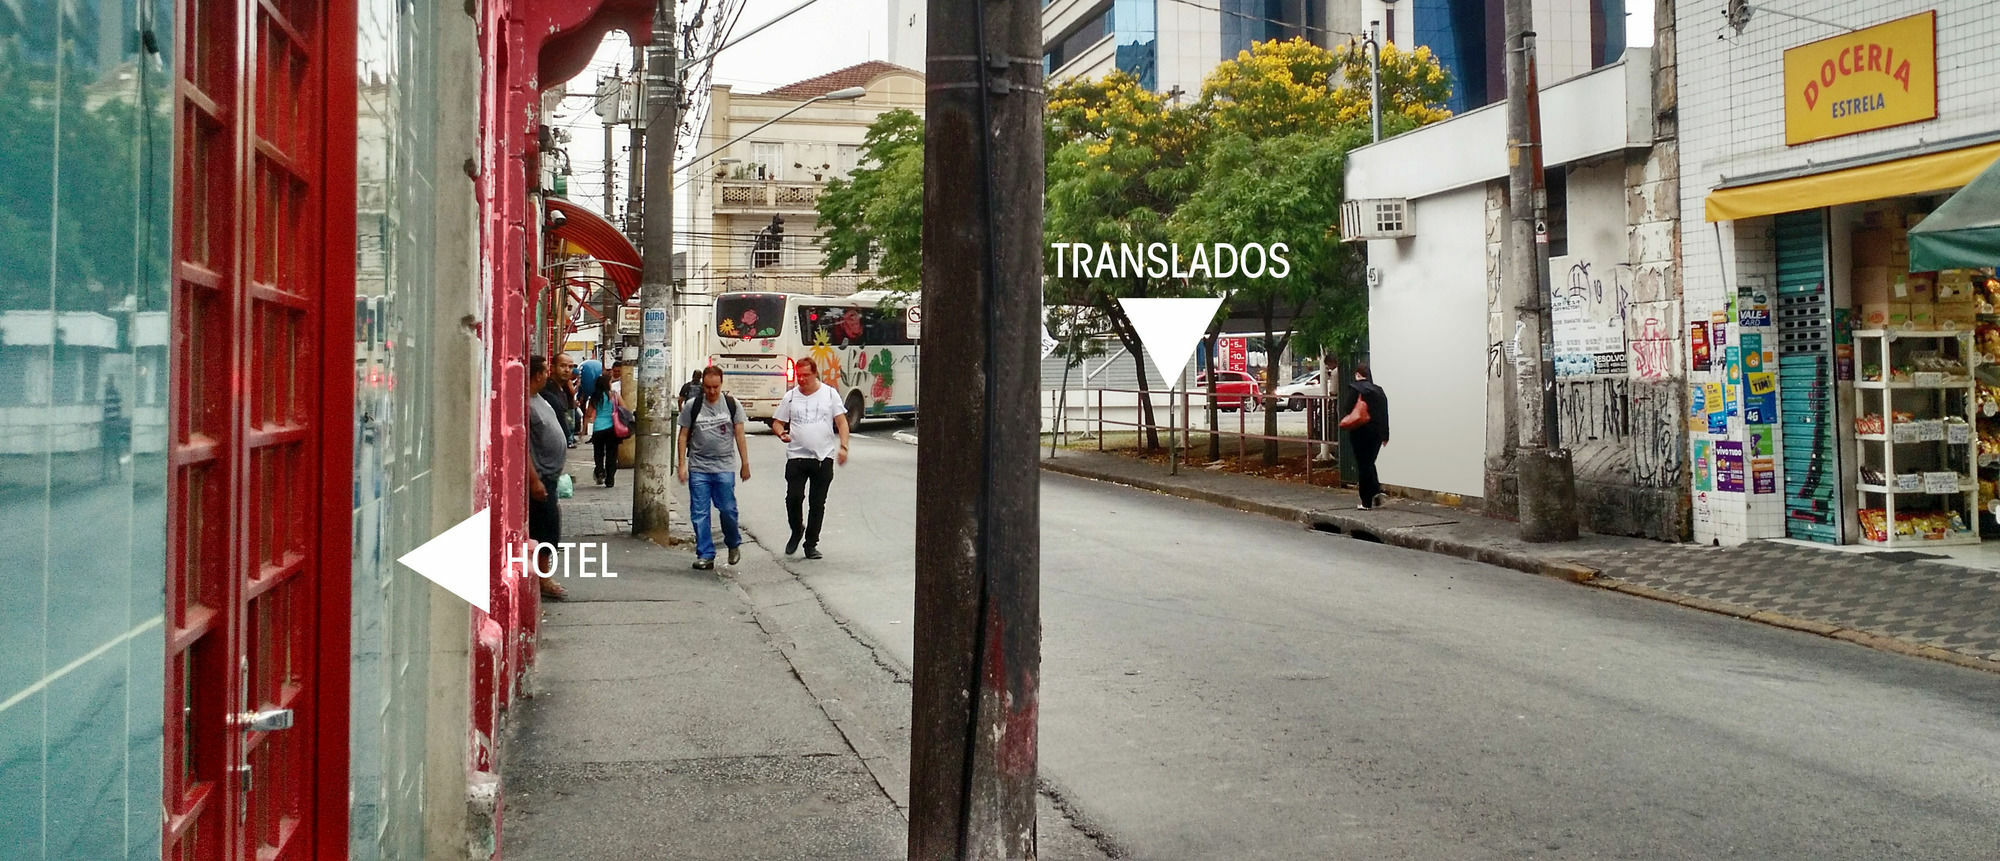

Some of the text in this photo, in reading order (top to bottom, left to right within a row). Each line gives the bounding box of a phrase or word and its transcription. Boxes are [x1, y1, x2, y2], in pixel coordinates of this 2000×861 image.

[1803, 43, 1911, 112] DOCERIA
[1832, 92, 1885, 118] ESTRELA
[1740, 310, 1761, 320] VALE
[1740, 319, 1760, 327] CARD
[1747, 411, 1759, 422] 4G
